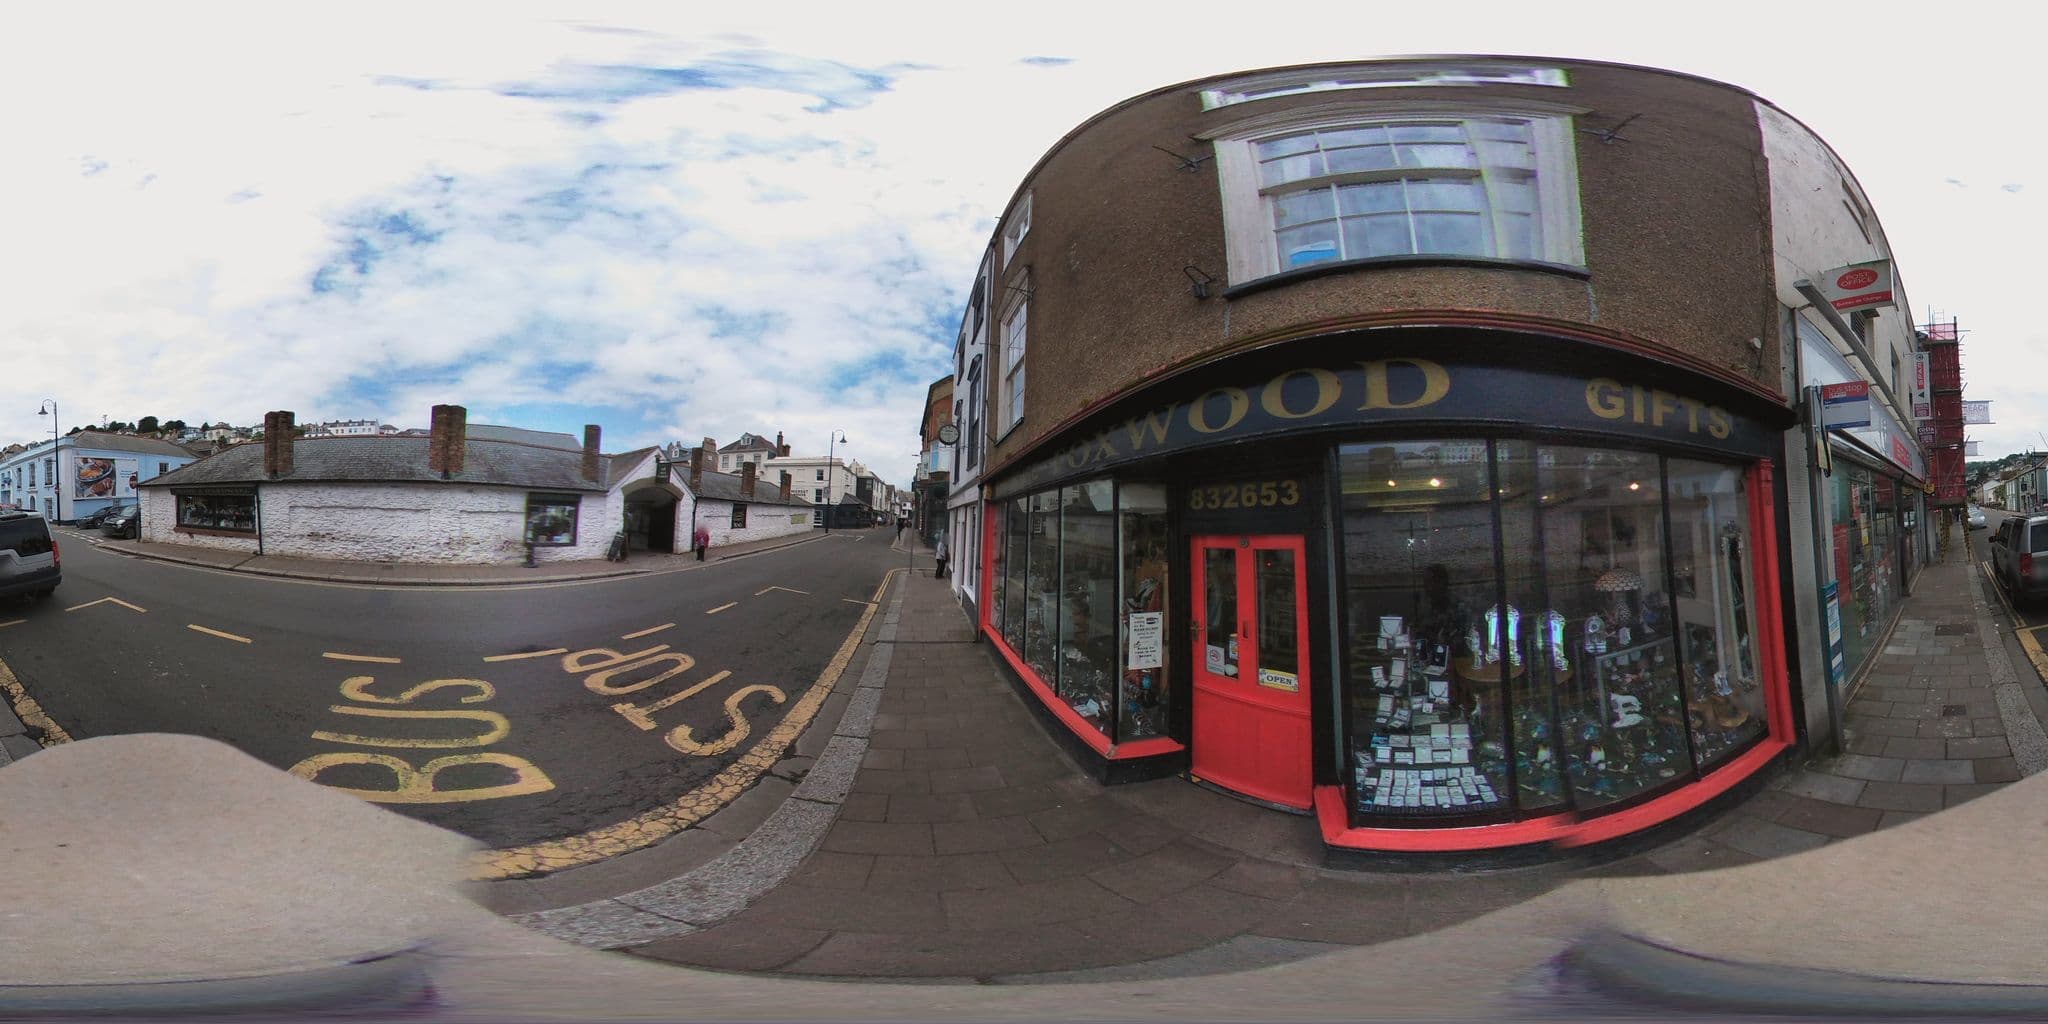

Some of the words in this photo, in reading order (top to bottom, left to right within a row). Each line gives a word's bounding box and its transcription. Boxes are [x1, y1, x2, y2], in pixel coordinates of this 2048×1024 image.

[1840, 275, 1874, 287] OFFICE
[1845, 271, 1869, 280] POST
[1844, 384, 1862, 393] stop
[1585, 376, 1732, 440] GIFTS
[1189, 479, 1301, 510] 832653
[1266, 674, 1293, 686] OPEN
[561, 644, 786, 757] STOP
[287, 676, 555, 804] BUS
